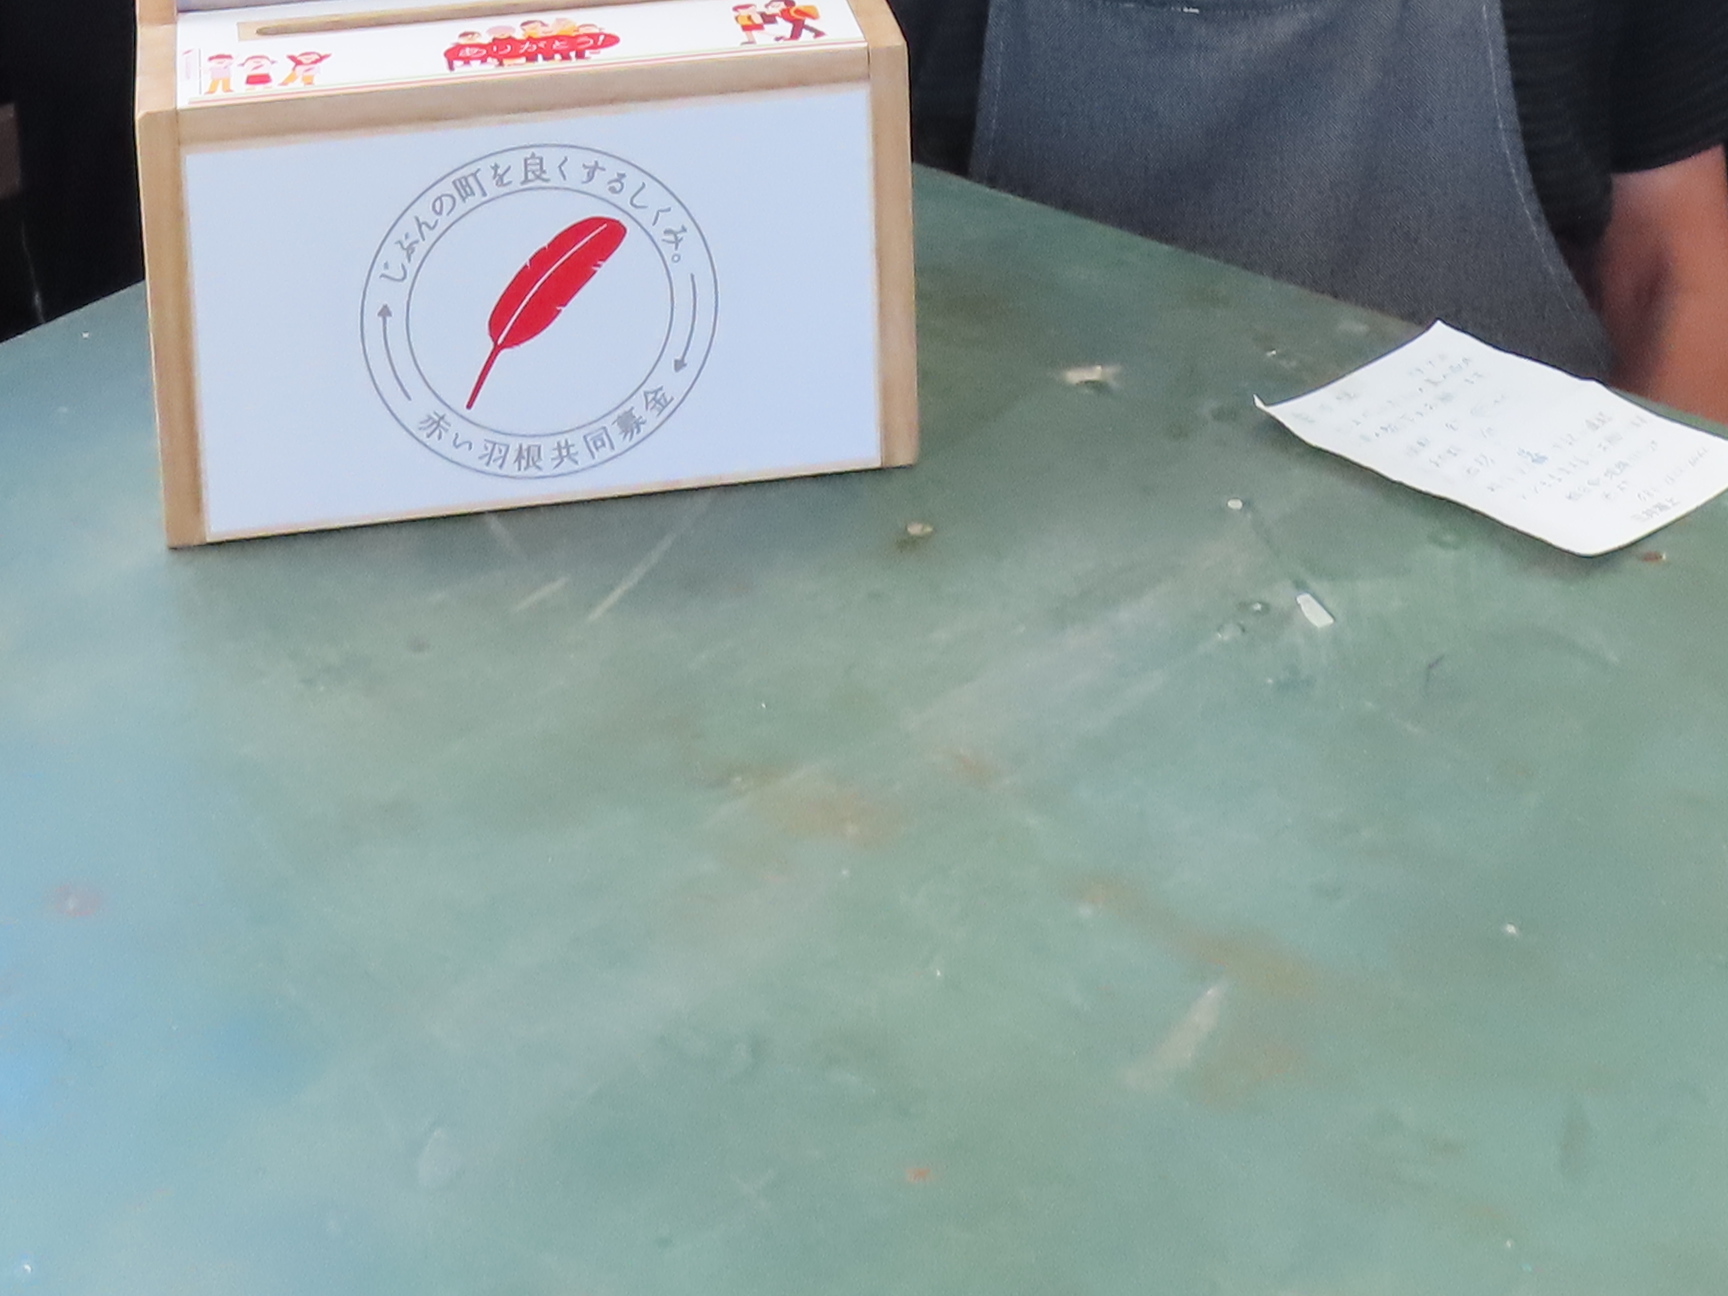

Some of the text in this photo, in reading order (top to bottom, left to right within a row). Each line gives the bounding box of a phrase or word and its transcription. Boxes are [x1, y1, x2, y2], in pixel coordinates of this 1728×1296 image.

[379, 150, 690, 286] じぶんの町を良くするしくみ。
[415, 382, 676, 475] 赤い羽根共同募金
